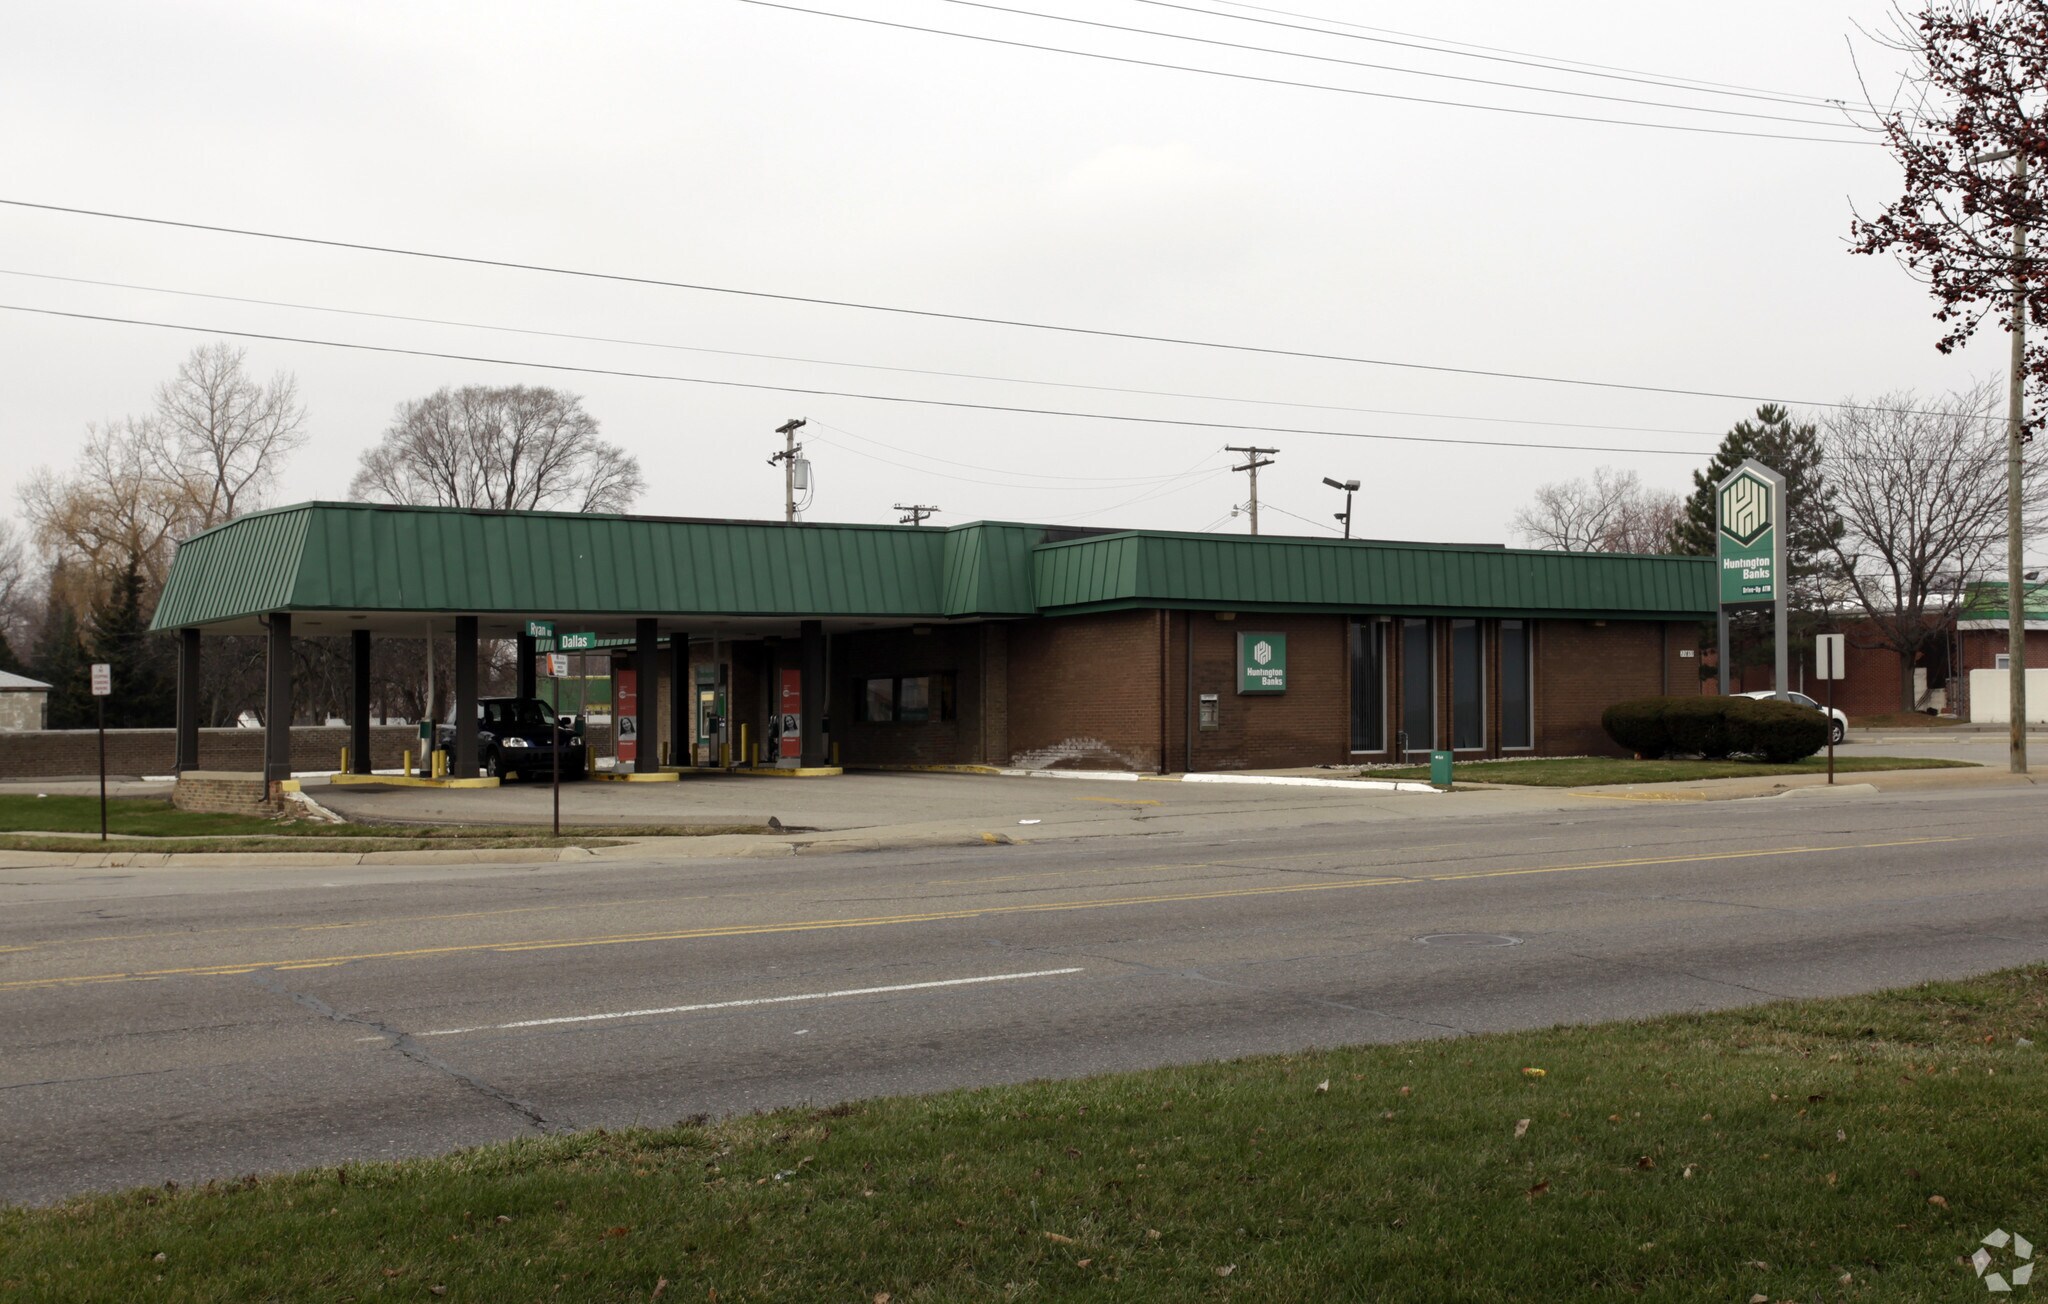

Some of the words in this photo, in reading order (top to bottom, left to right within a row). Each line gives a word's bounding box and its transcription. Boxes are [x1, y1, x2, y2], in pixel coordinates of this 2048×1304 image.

[1724, 557, 1770, 570] Huntington
[1743, 568, 1770, 580] Banks
[530, 622, 546, 637] Ryan
[562, 635, 588, 648] Dallas
[1247, 667, 1282, 678] Huntington
[1262, 677, 1282, 685] Banks
